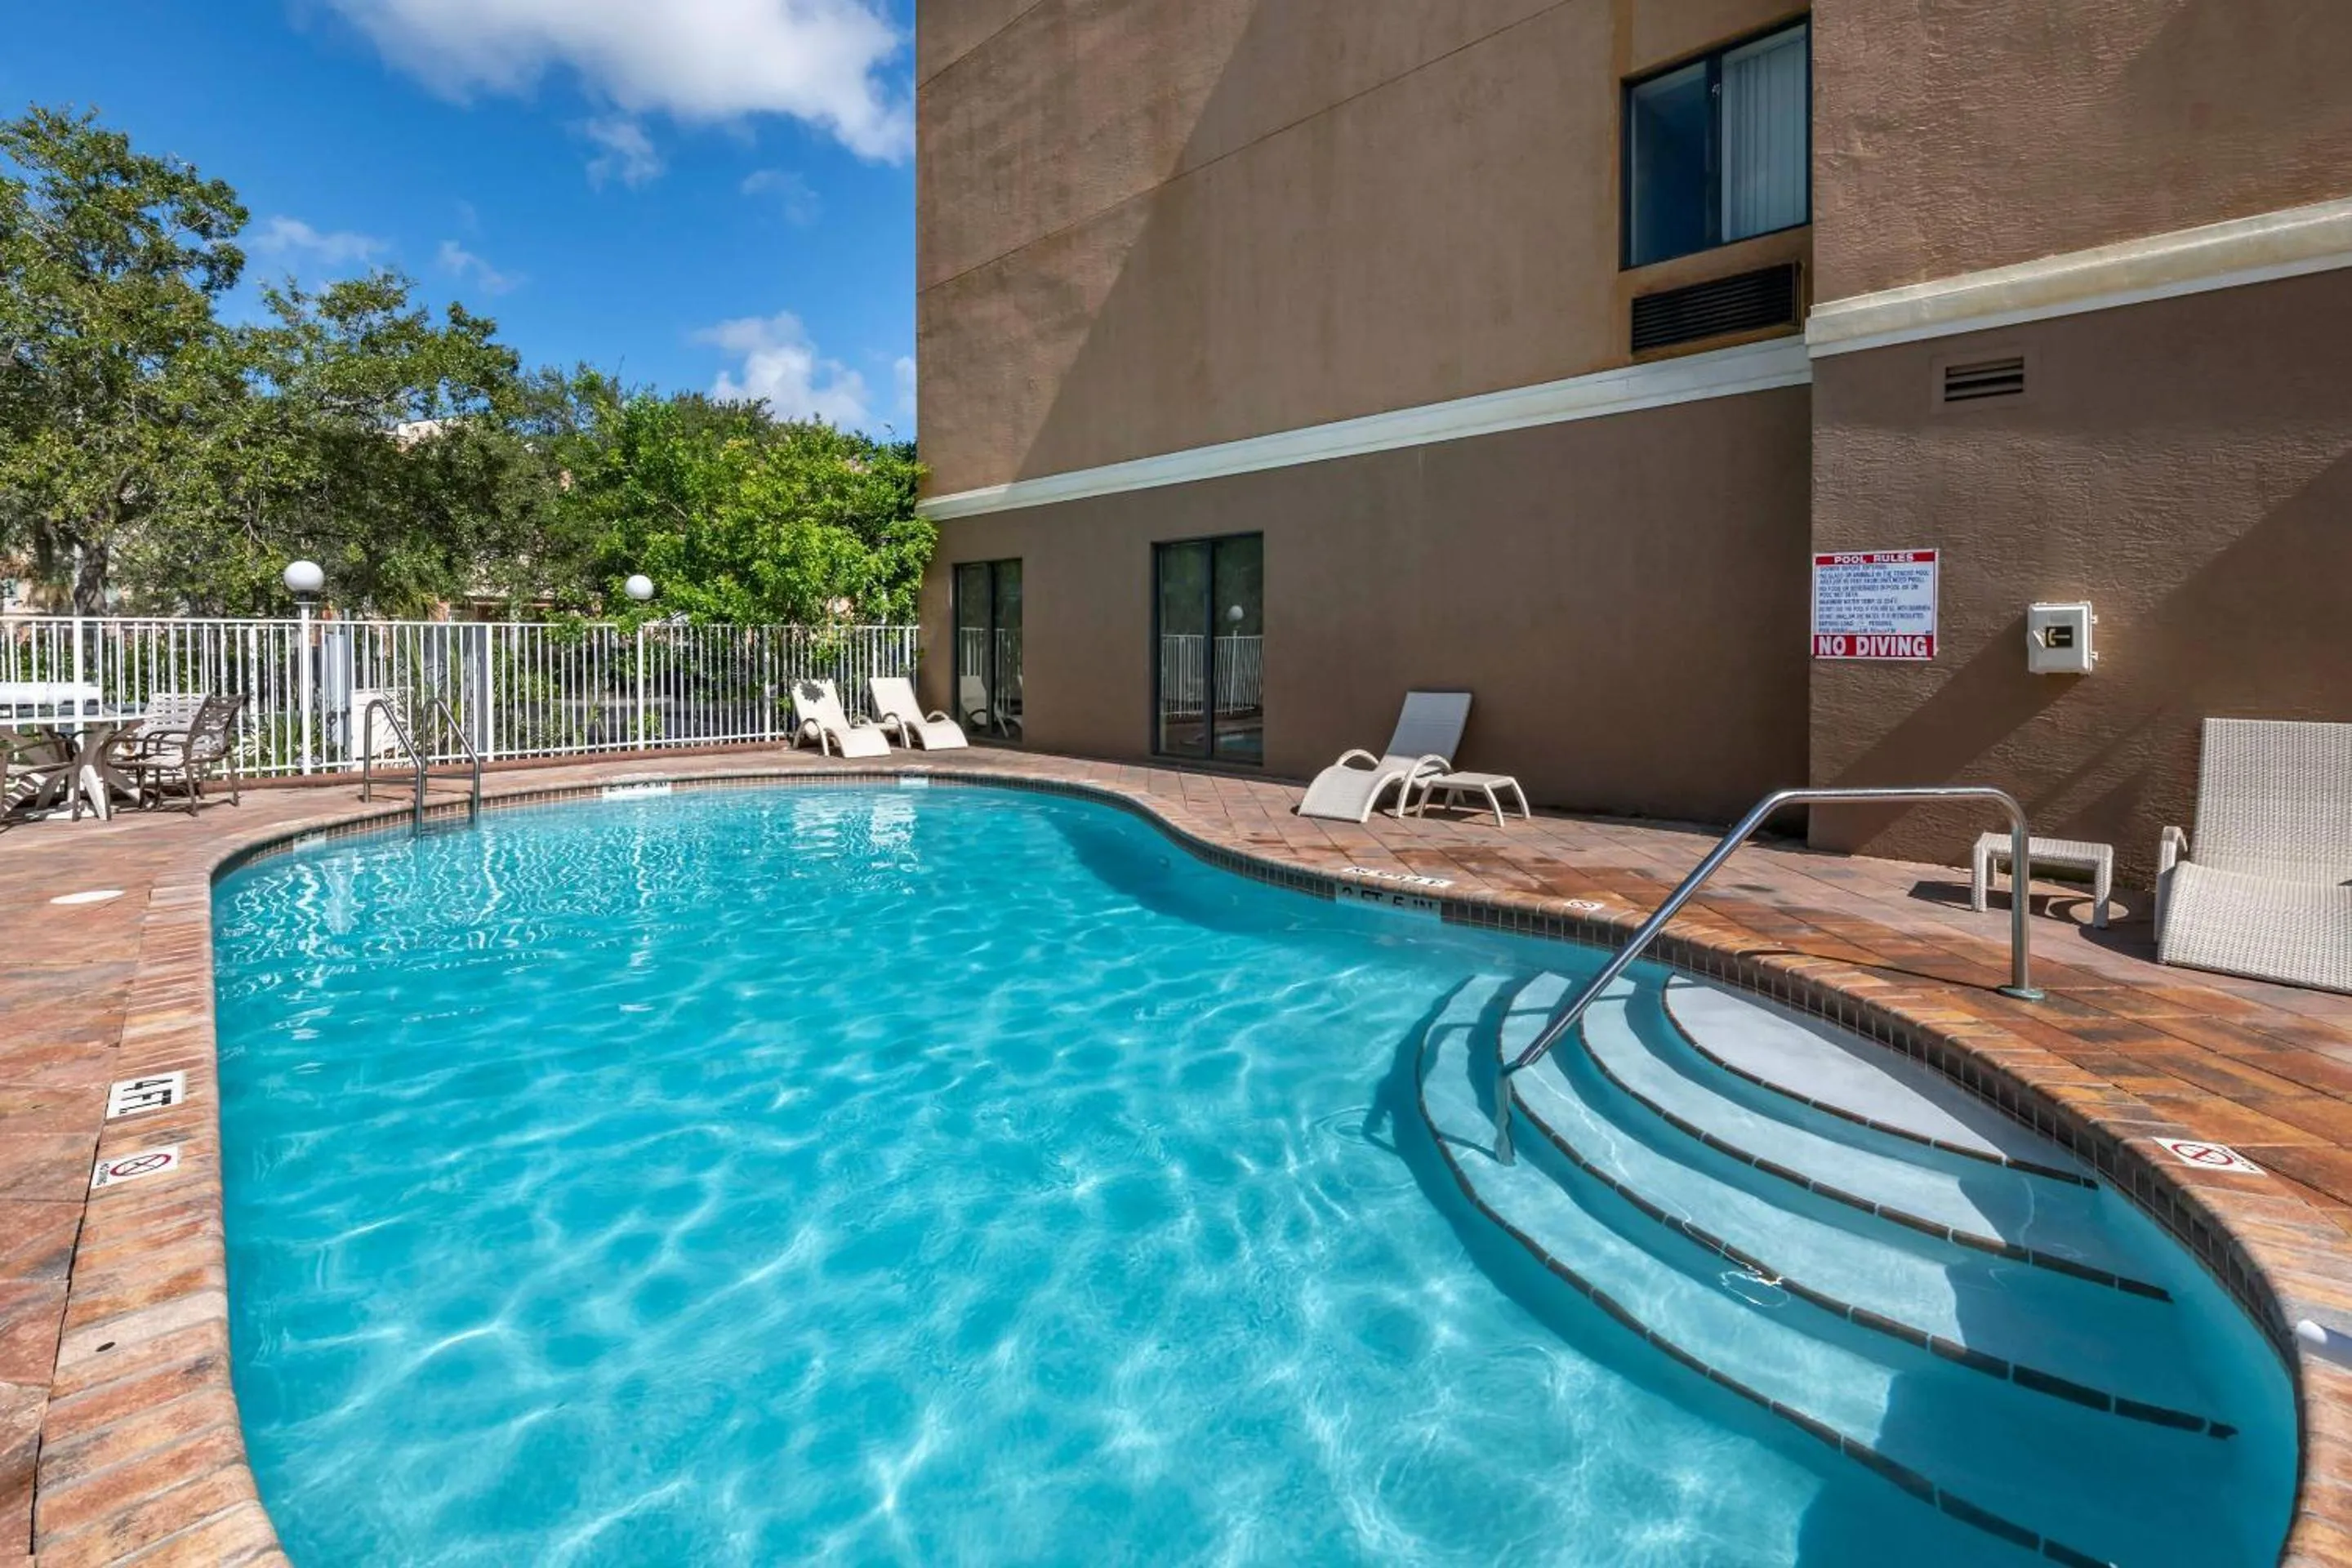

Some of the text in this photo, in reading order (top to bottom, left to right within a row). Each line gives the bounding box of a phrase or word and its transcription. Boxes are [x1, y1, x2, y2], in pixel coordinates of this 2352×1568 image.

[1833, 553, 1914, 564] POOL RULES
[1818, 635, 1927, 657] NO DIVING
